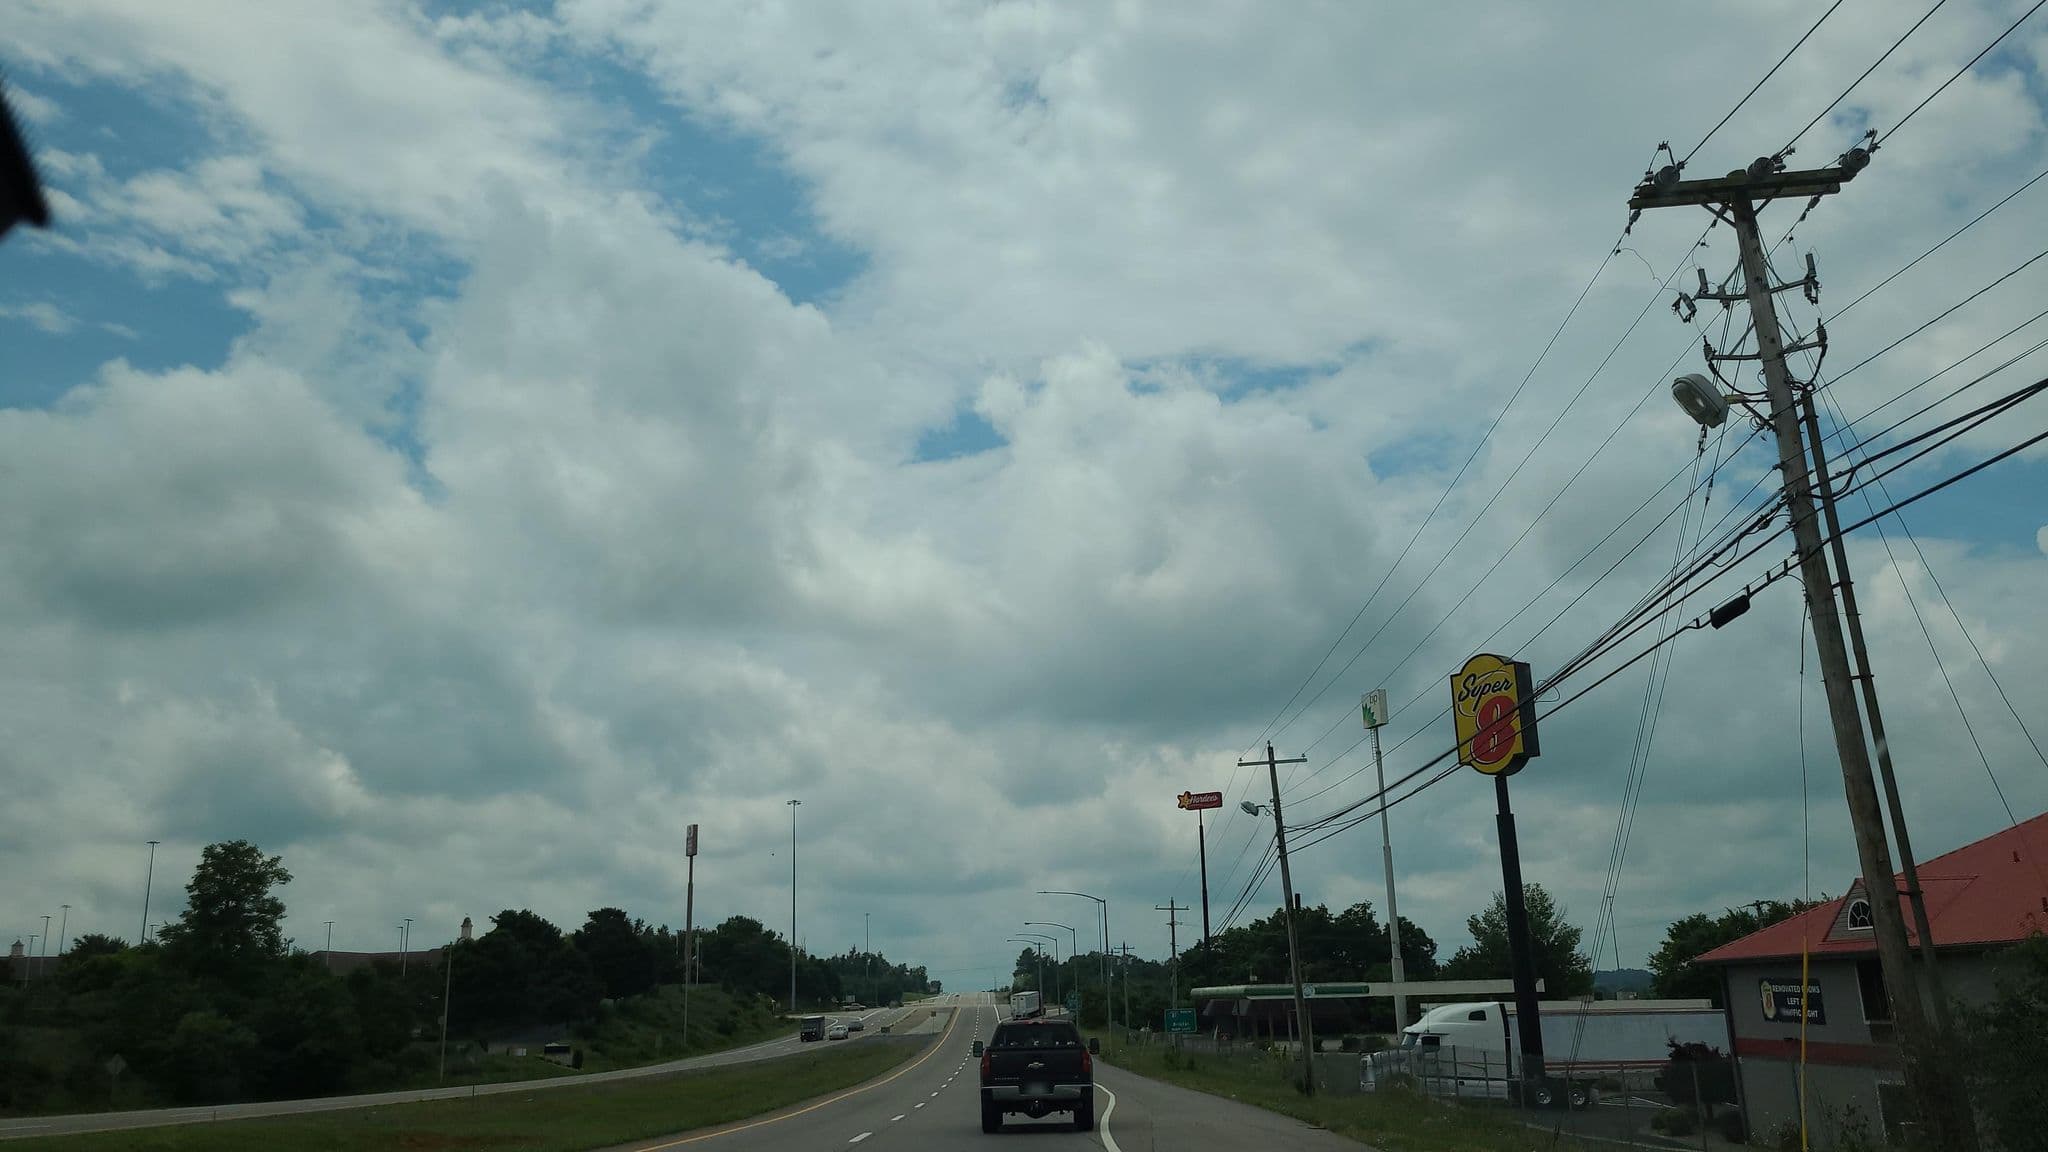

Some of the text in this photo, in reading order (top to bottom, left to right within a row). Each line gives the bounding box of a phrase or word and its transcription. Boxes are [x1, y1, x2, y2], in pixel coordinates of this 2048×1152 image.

[1457, 673, 1513, 712] Super
[1470, 695, 1517, 764] 8
[1772, 984, 1800, 993] RENOVATED
[1787, 997, 1800, 1005] LEFT
